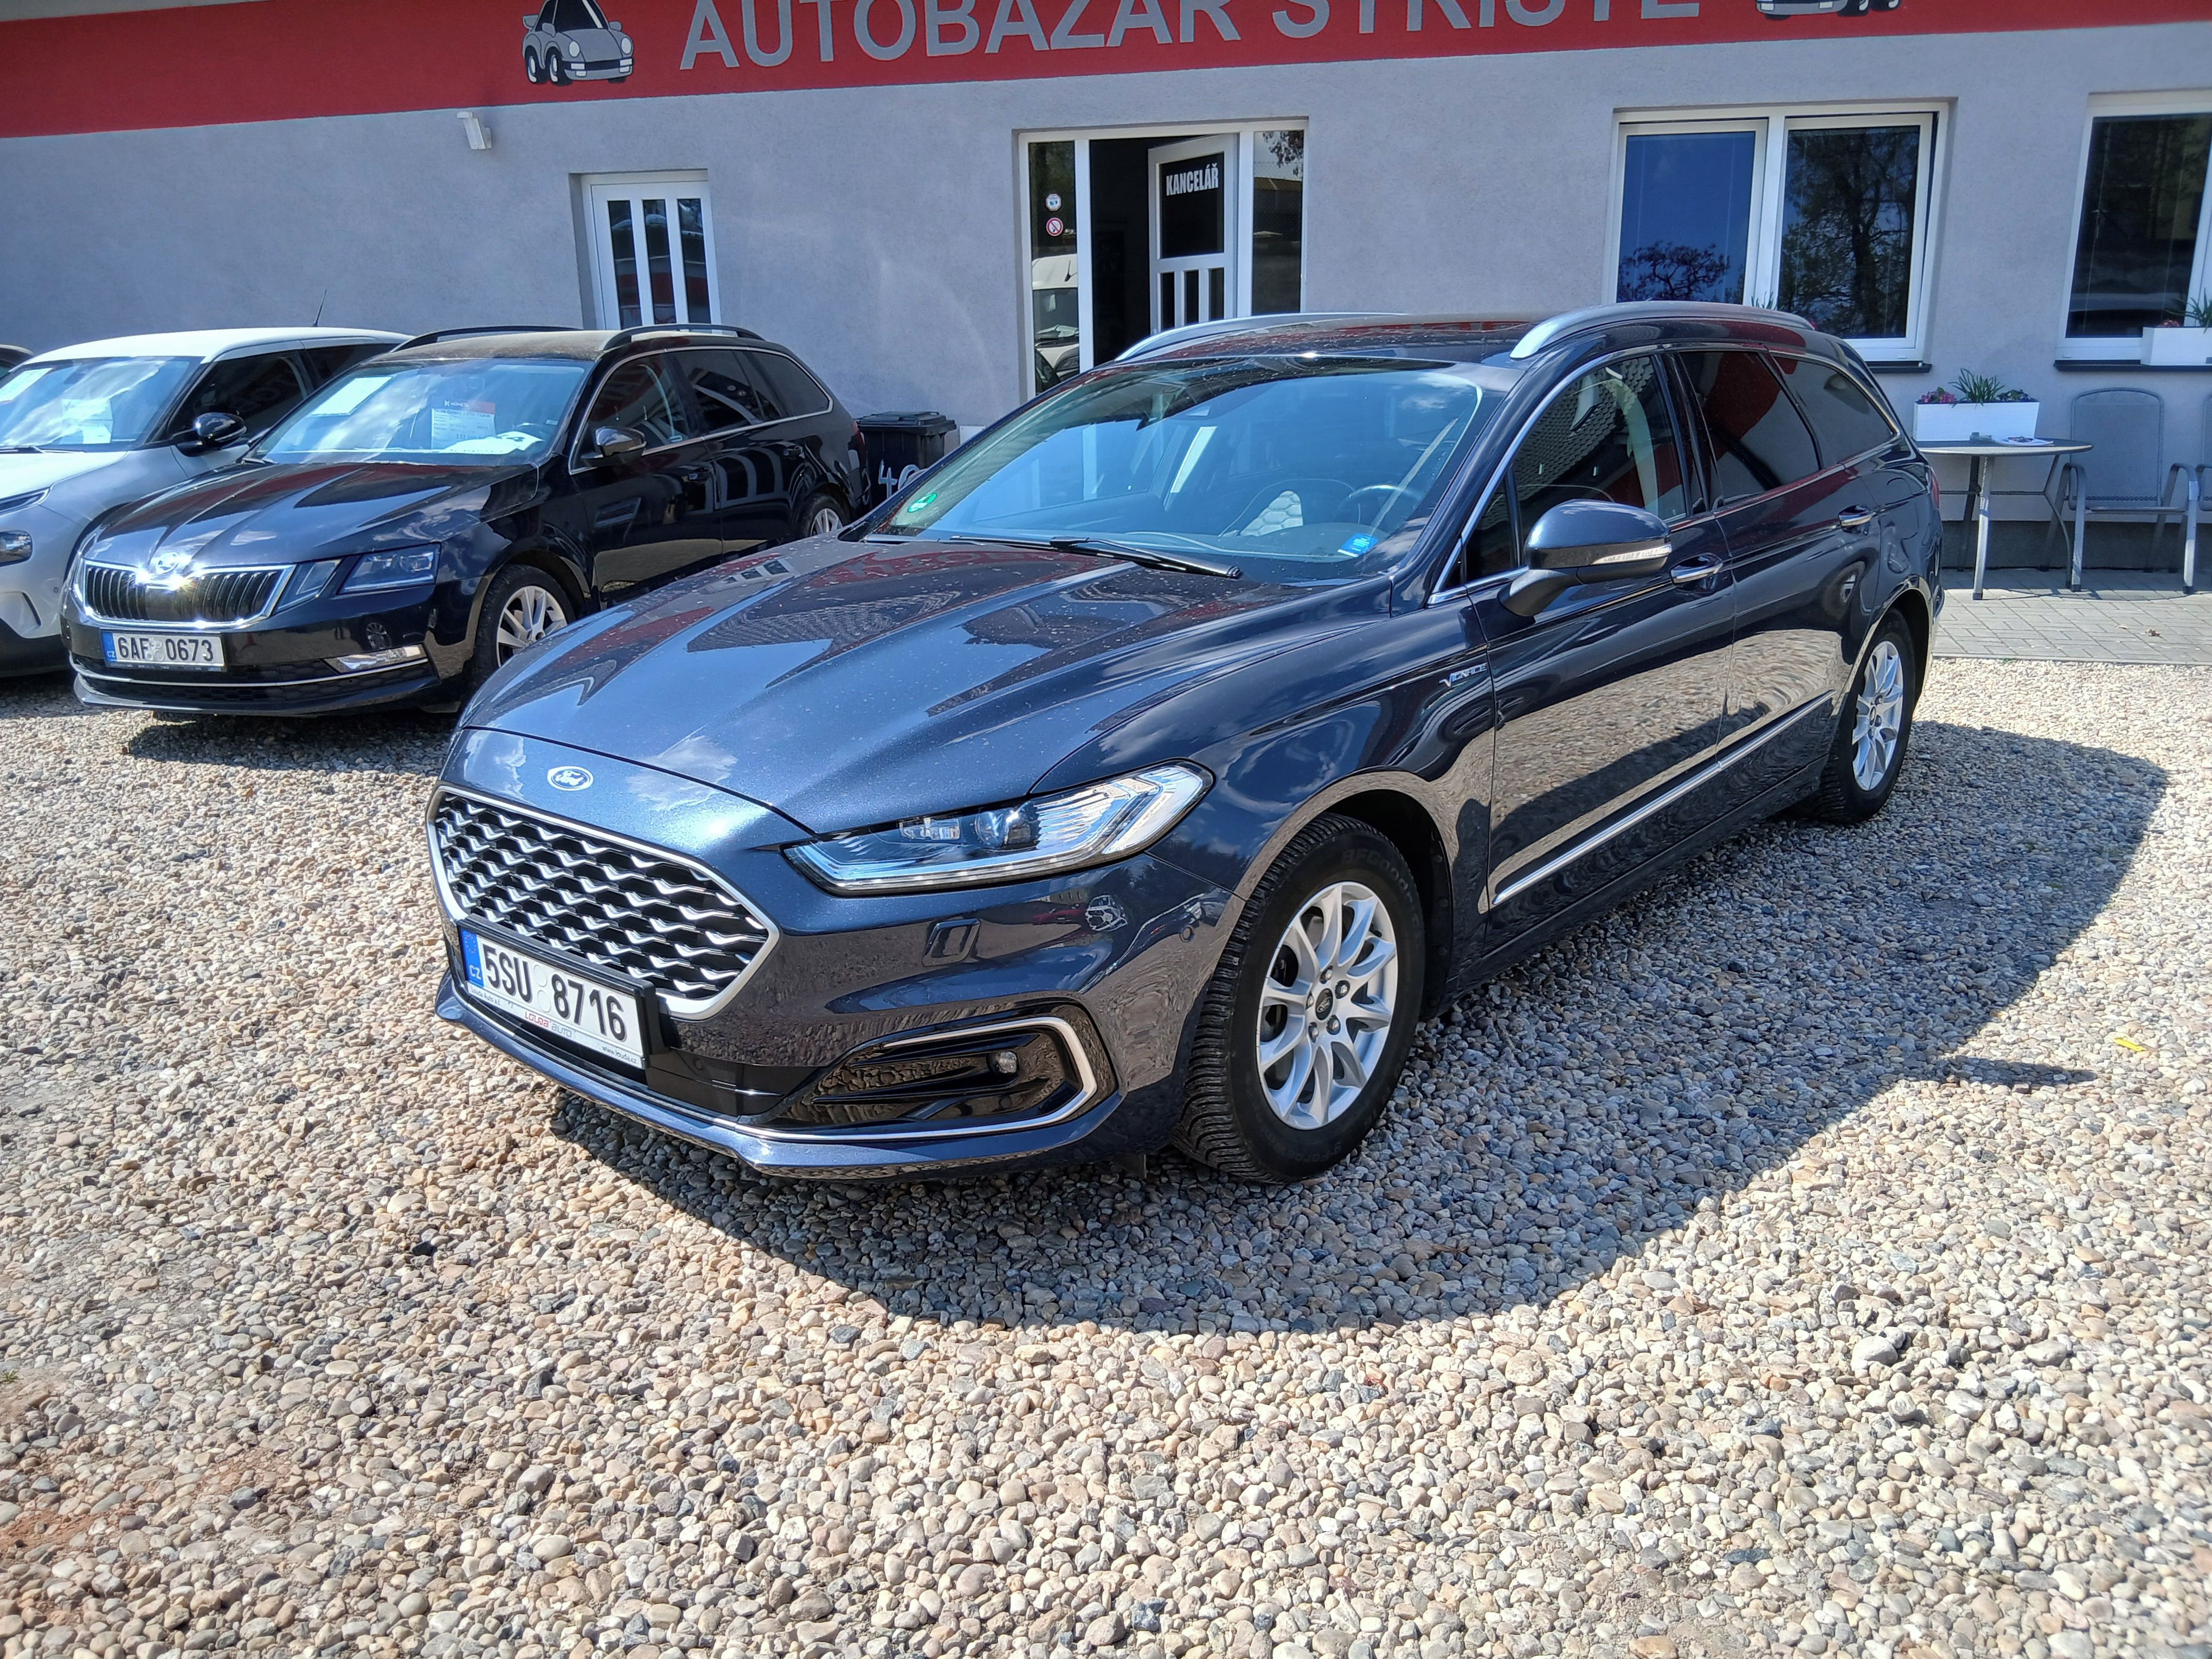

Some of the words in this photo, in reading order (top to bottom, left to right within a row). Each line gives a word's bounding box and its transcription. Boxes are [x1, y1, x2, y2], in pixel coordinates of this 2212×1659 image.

[679, 0, 1242, 70] AUTOBAZAR
[1166, 163, 1218, 196] KANCELÁŘ
[107, 651, 115, 659] CZ
[118, 636, 149, 660] 6AF
[165, 639, 214, 661] 0673
[470, 964, 482, 980] CZ
[483, 943, 532, 1003] 5SU
[551, 973, 627, 1042] 8716
